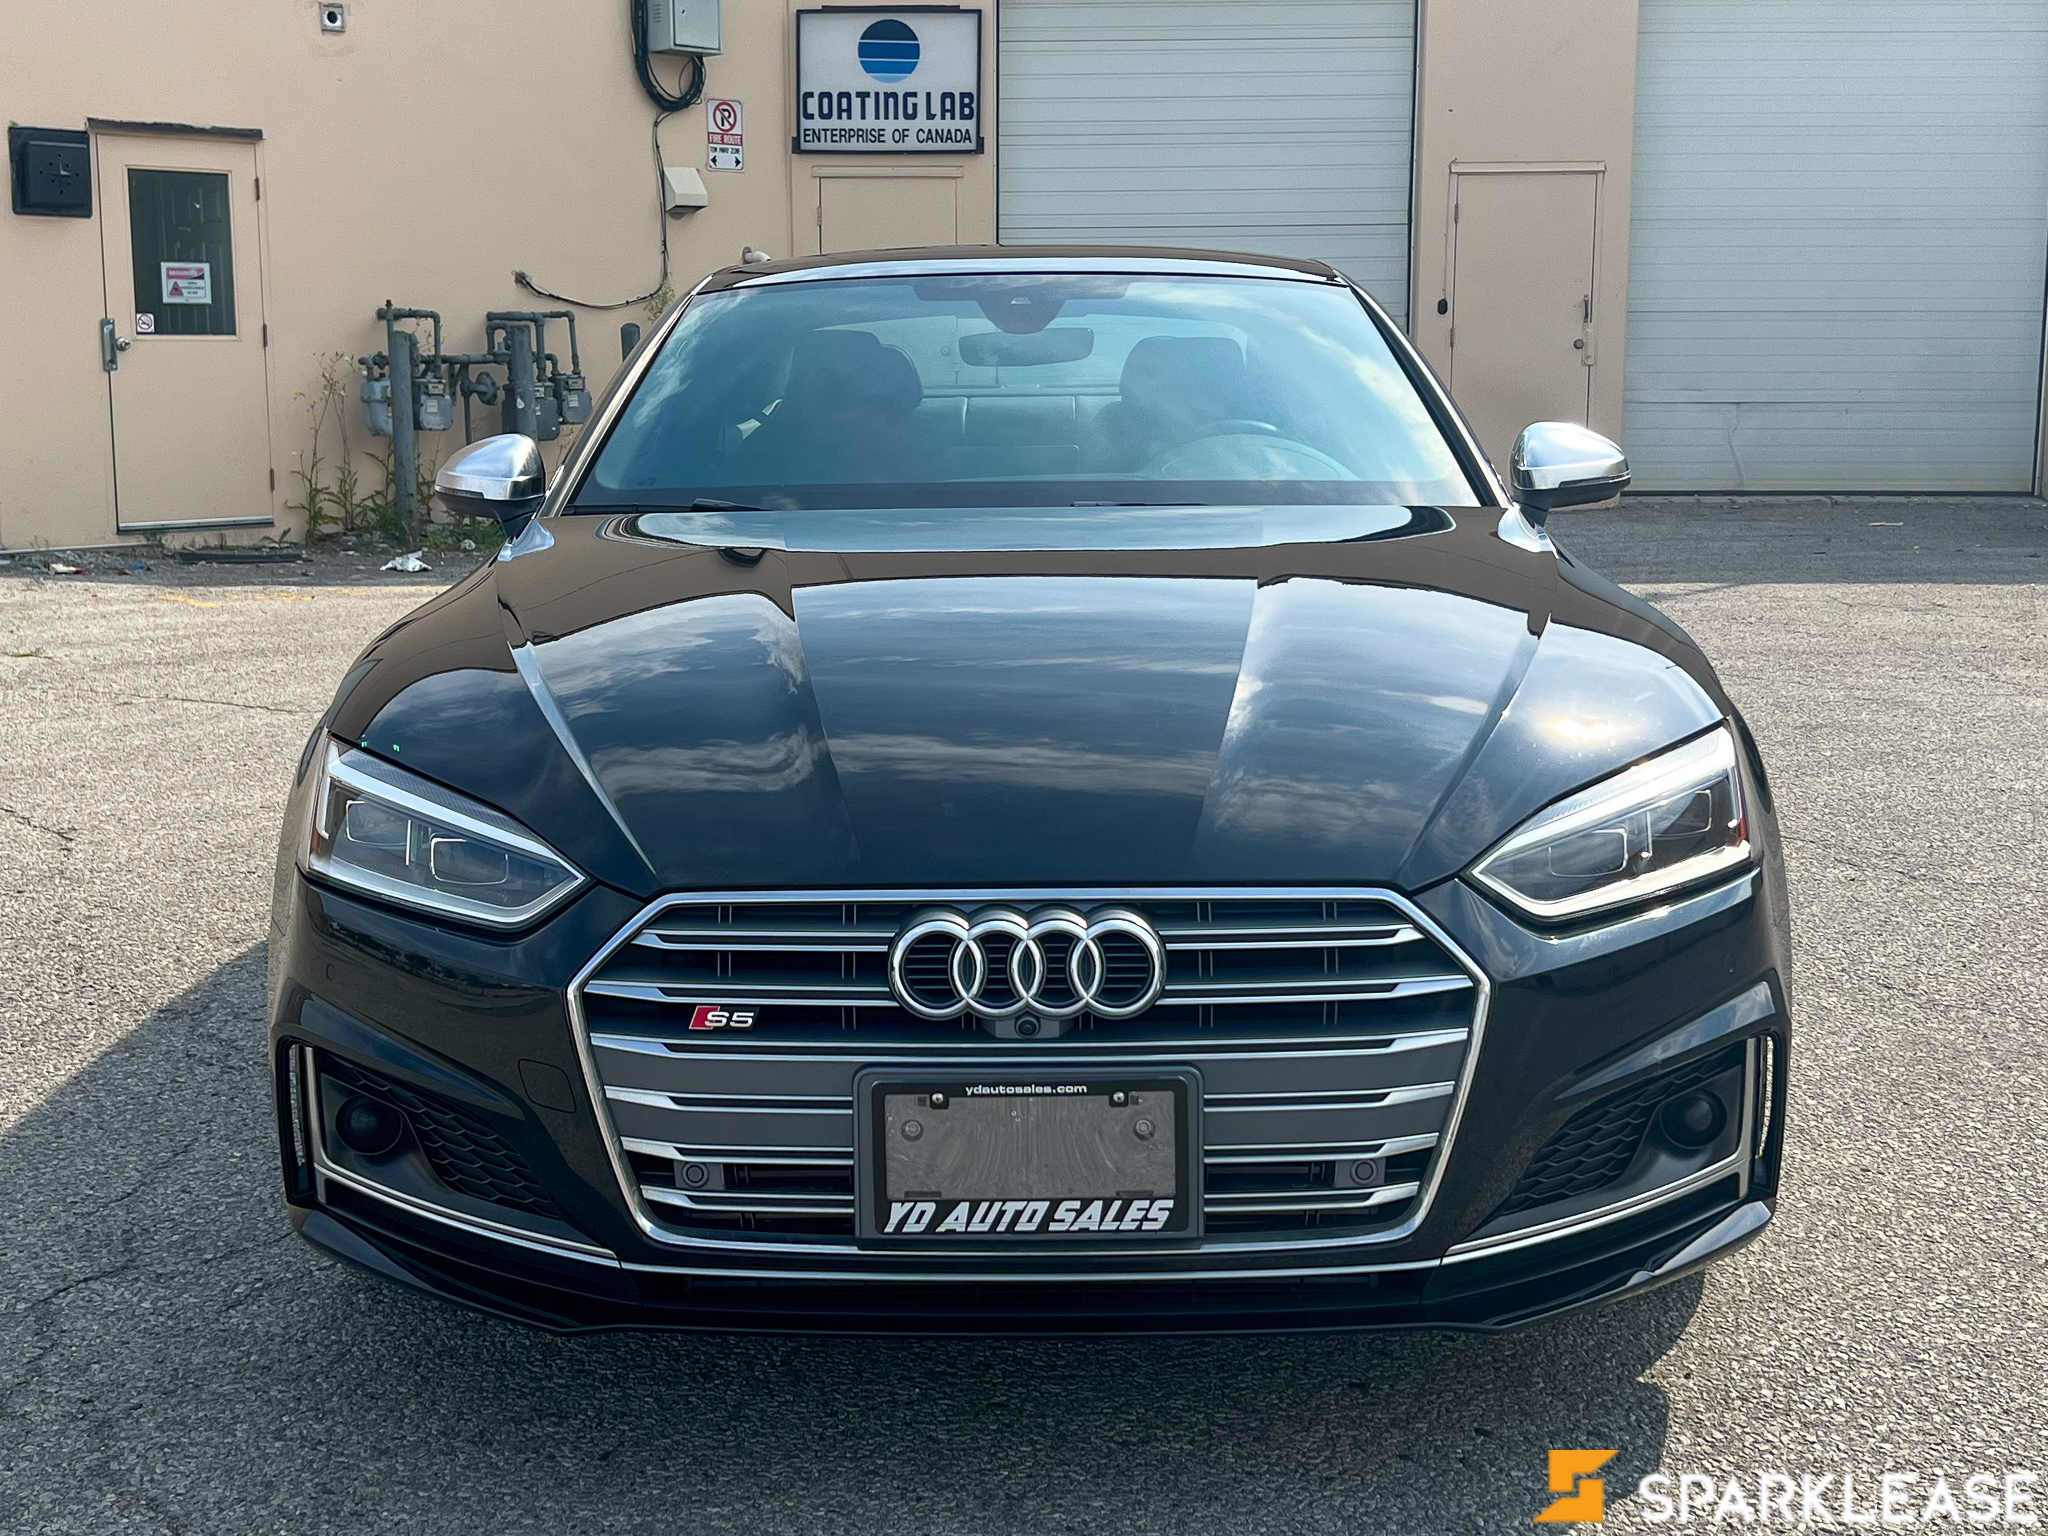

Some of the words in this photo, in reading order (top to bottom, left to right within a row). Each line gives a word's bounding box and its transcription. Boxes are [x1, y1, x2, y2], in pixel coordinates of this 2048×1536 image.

[802, 91, 918, 121] COATING
[926, 91, 975, 121] LAB
[803, 128, 886, 144] ENTERPRISE
[892, 128, 910, 144] OF
[916, 128, 972, 144] CANADA
[704, 1011, 754, 1028] S5
[965, 1084, 1088, 1096] ydautosales.com
[884, 1202, 937, 1233] YD
[935, 1201, 1050, 1233] AUTO
[1048, 1199, 1174, 1233] SALES
